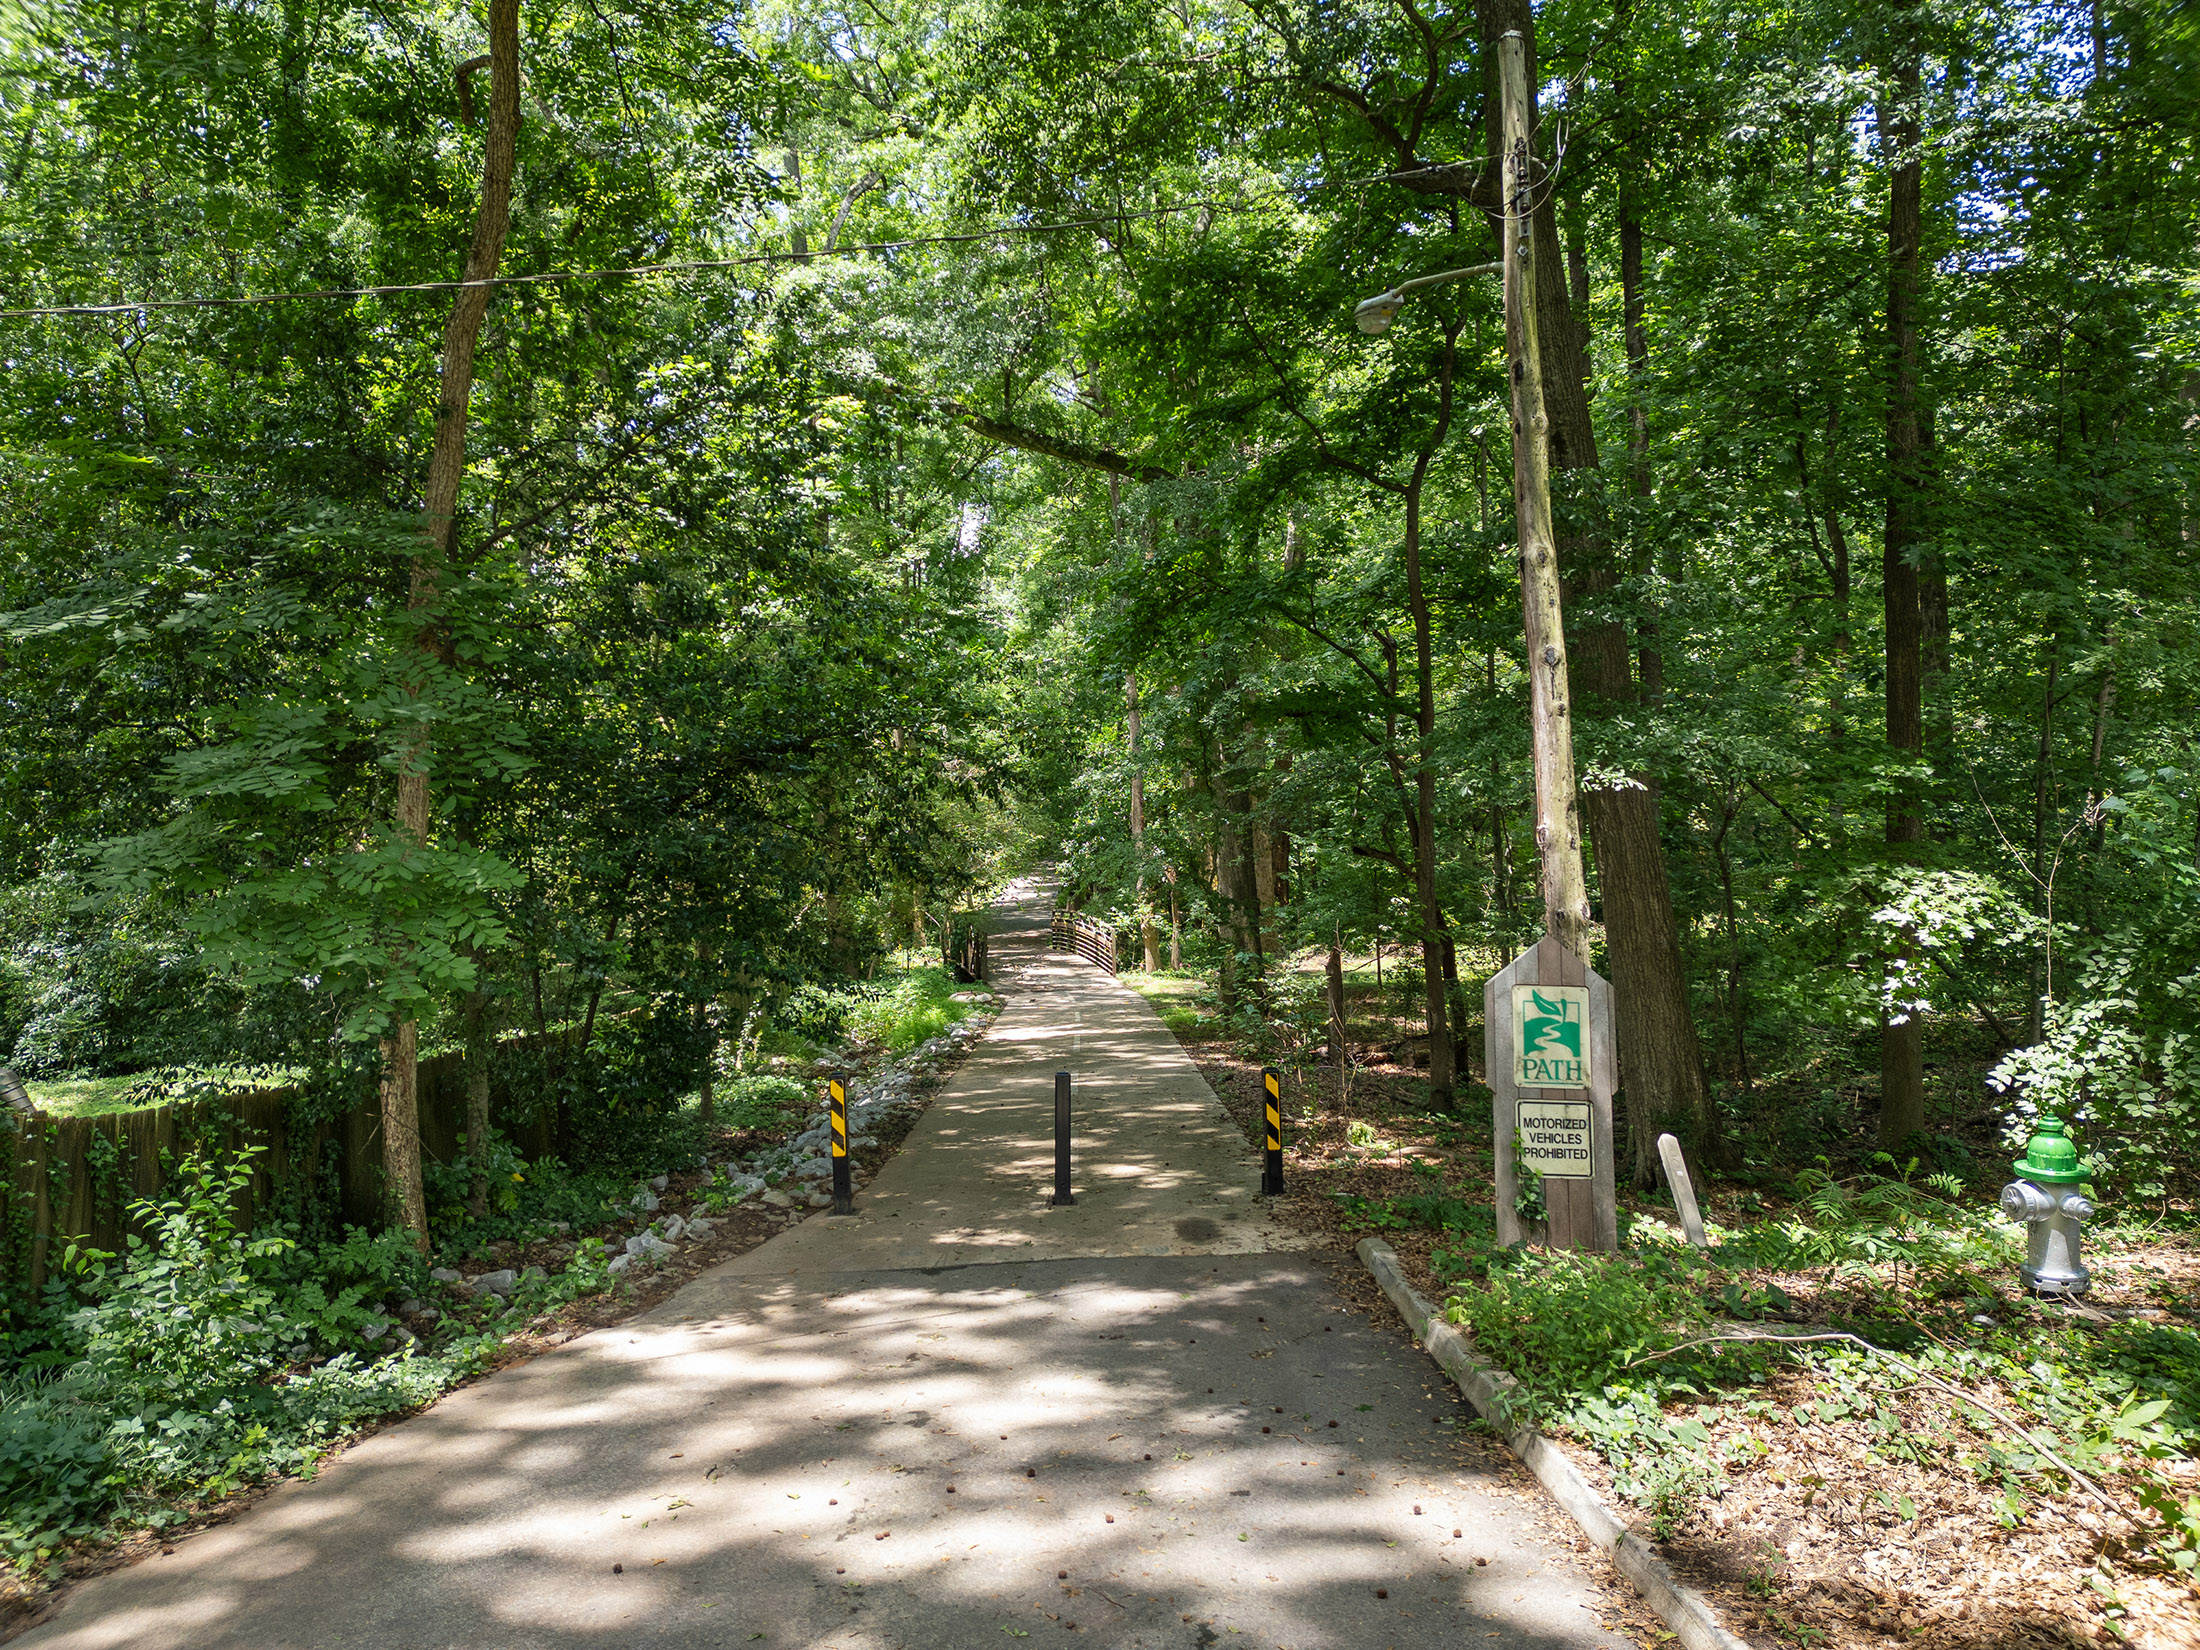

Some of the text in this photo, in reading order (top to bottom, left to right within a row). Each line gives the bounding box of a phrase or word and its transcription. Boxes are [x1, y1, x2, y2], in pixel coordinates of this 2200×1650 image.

[1523, 1058, 1582, 1081] PATH
[1523, 1118, 1587, 1130] MOTORIZED
[1529, 1133, 1582, 1145] VEHICLES
[1523, 1147, 1588, 1160] PROHIBITED
